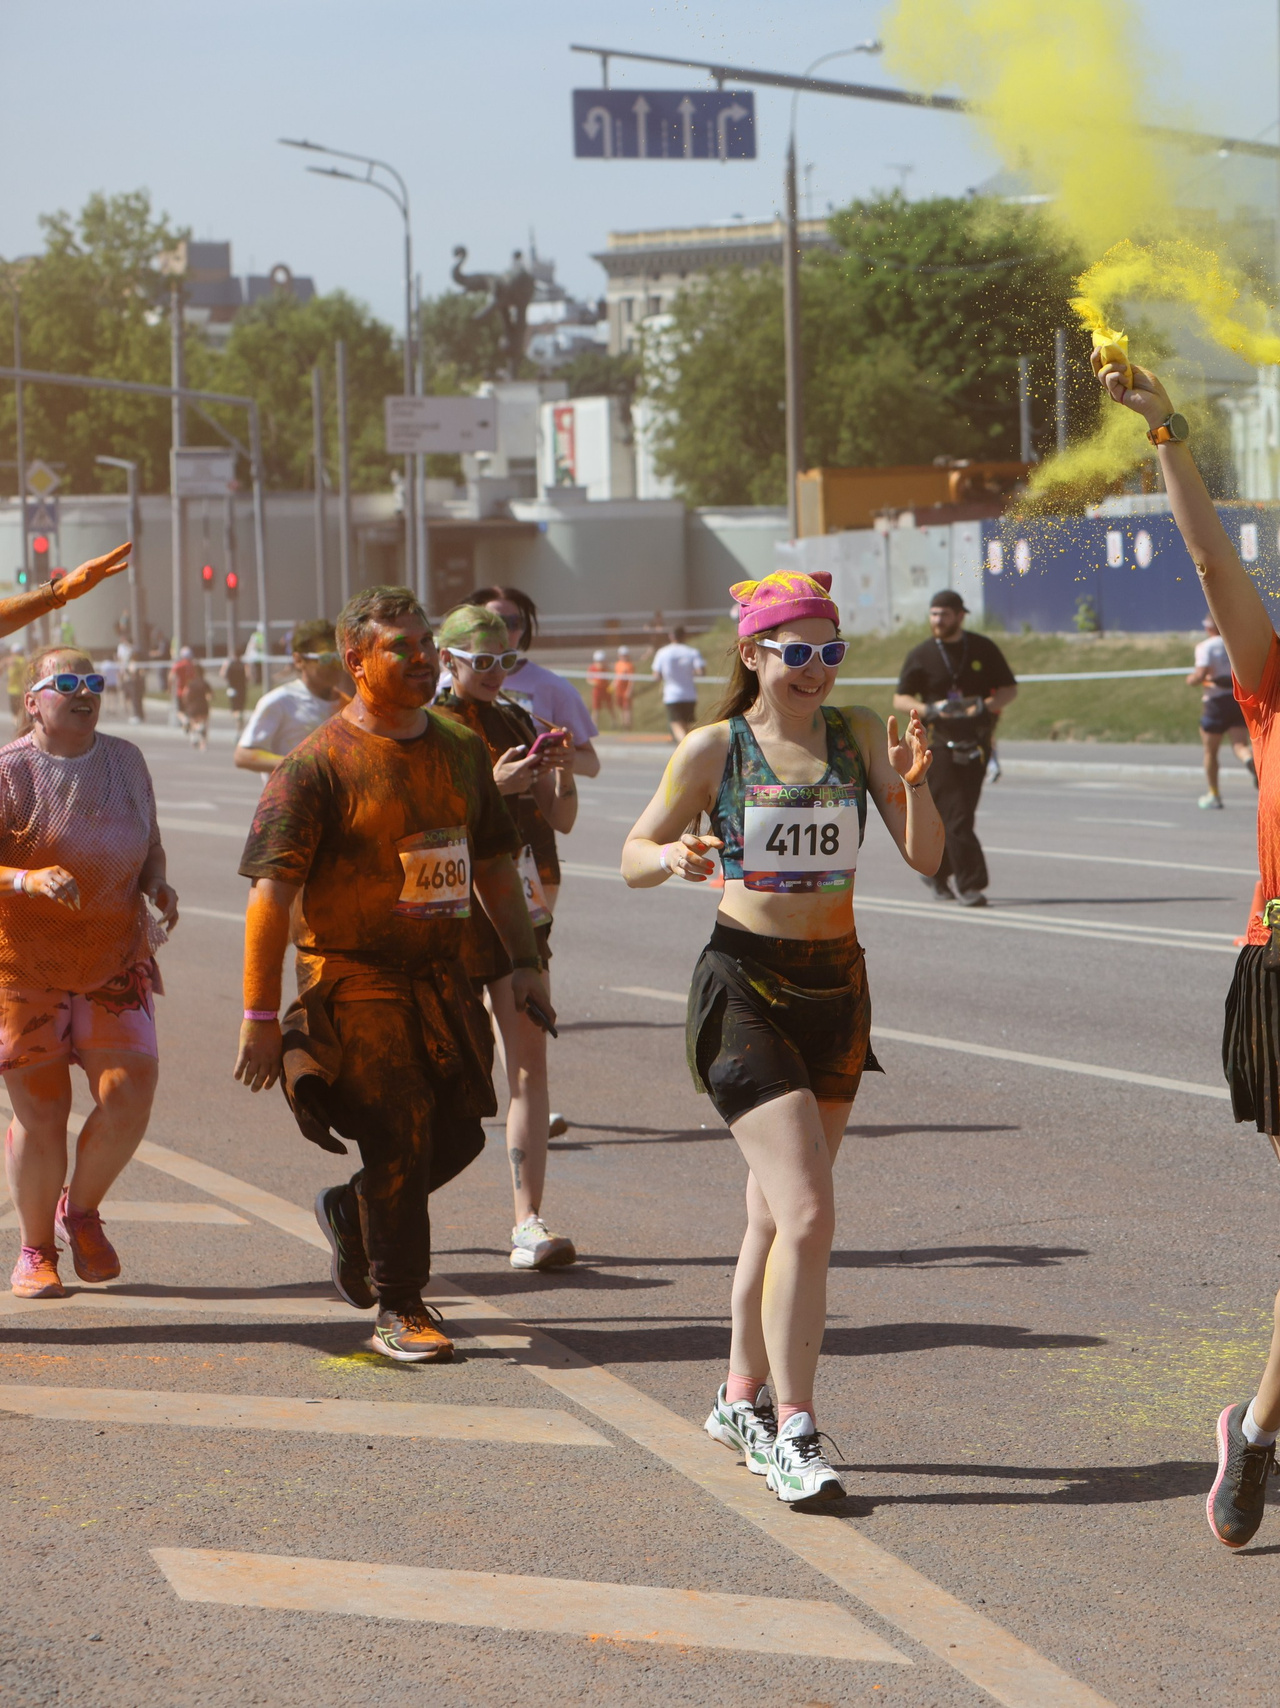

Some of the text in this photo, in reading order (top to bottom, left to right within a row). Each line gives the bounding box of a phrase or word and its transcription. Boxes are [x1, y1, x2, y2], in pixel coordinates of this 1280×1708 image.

[813, 799, 856, 808] 2026
[766, 823, 839, 856] 4118
[416, 858, 467, 891] 4680
